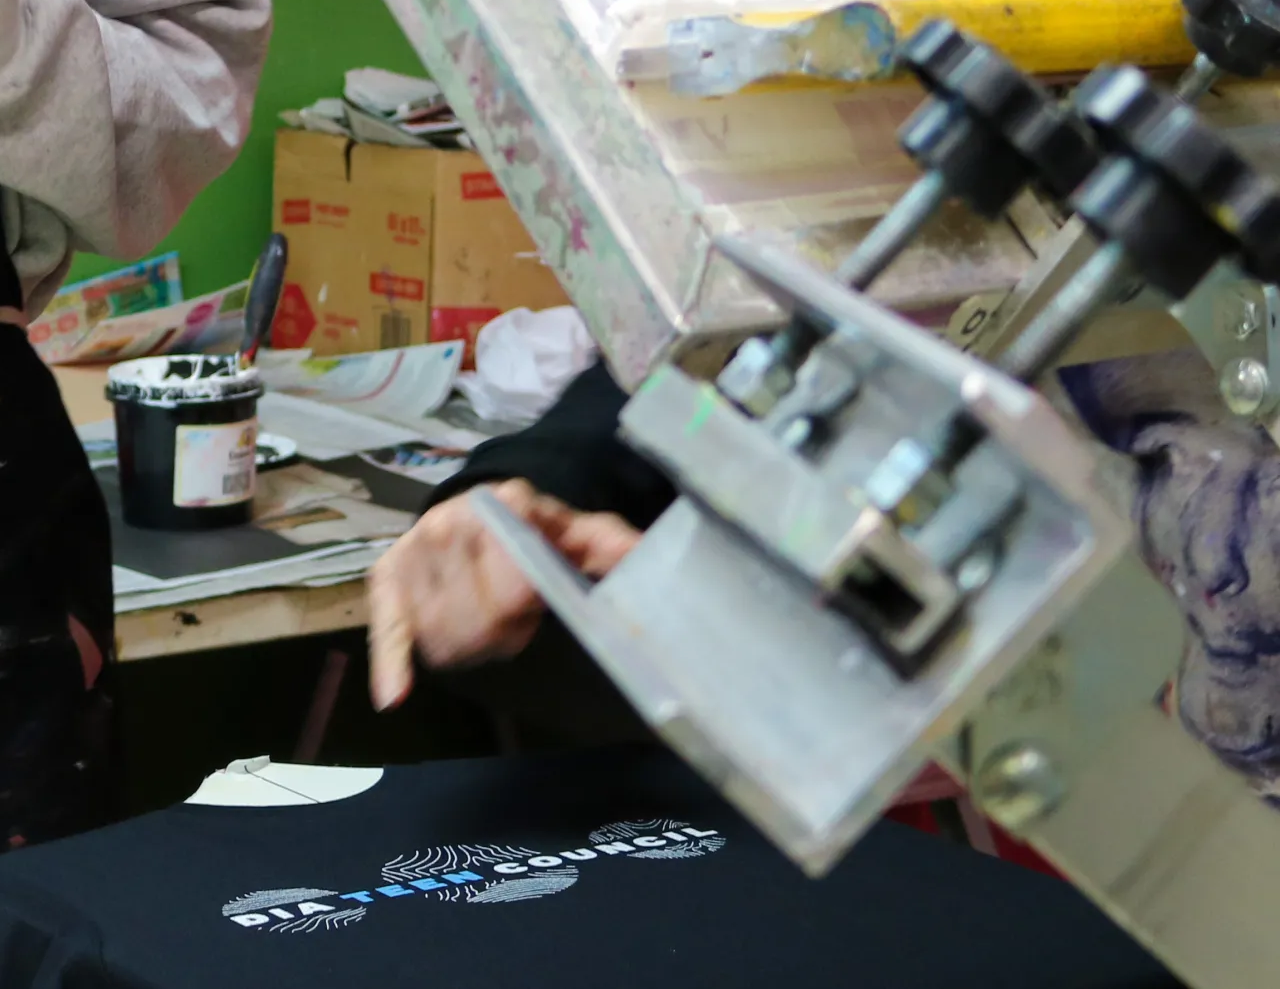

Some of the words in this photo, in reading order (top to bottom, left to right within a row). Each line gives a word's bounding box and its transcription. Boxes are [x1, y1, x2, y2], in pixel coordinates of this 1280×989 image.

[229, 898, 336, 928] DIA
[339, 869, 484, 904] TEEN
[492, 823, 721, 876] COUNCIL
